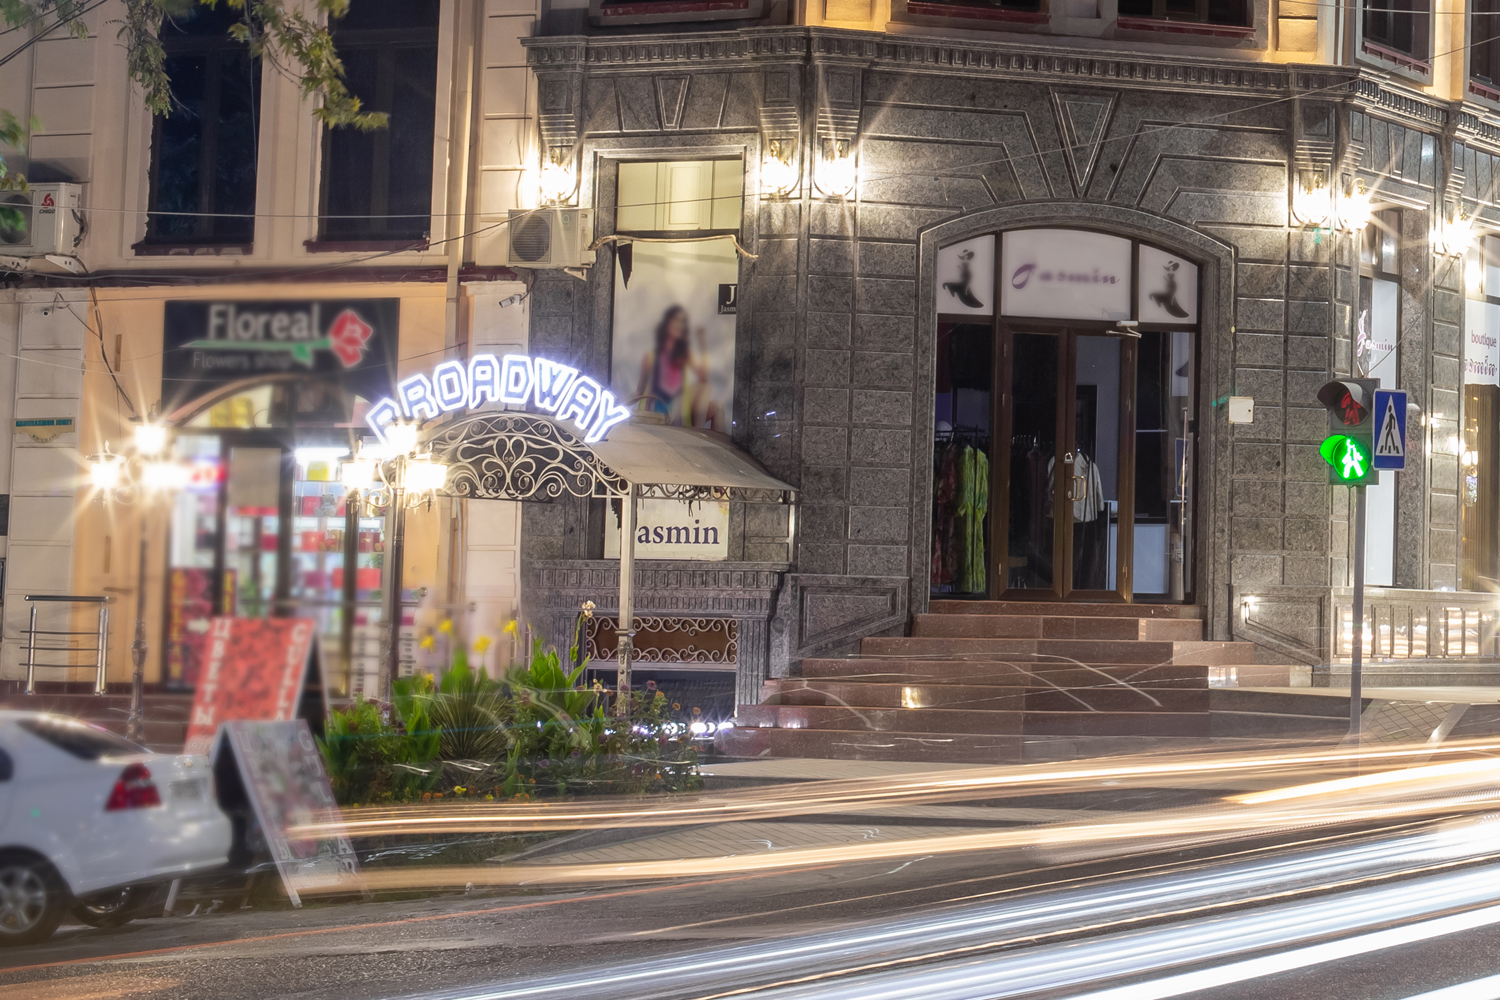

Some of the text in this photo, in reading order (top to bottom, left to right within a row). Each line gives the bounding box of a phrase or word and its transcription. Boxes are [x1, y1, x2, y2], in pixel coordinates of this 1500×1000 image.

[725, 285, 737, 305] J
[208, 303, 321, 340] Floreal
[1471, 329, 1497, 349] boutique
[193, 351, 248, 369] Flowers
[637, 518, 720, 545] asmin
[275, 622, 308, 721] GULLA
